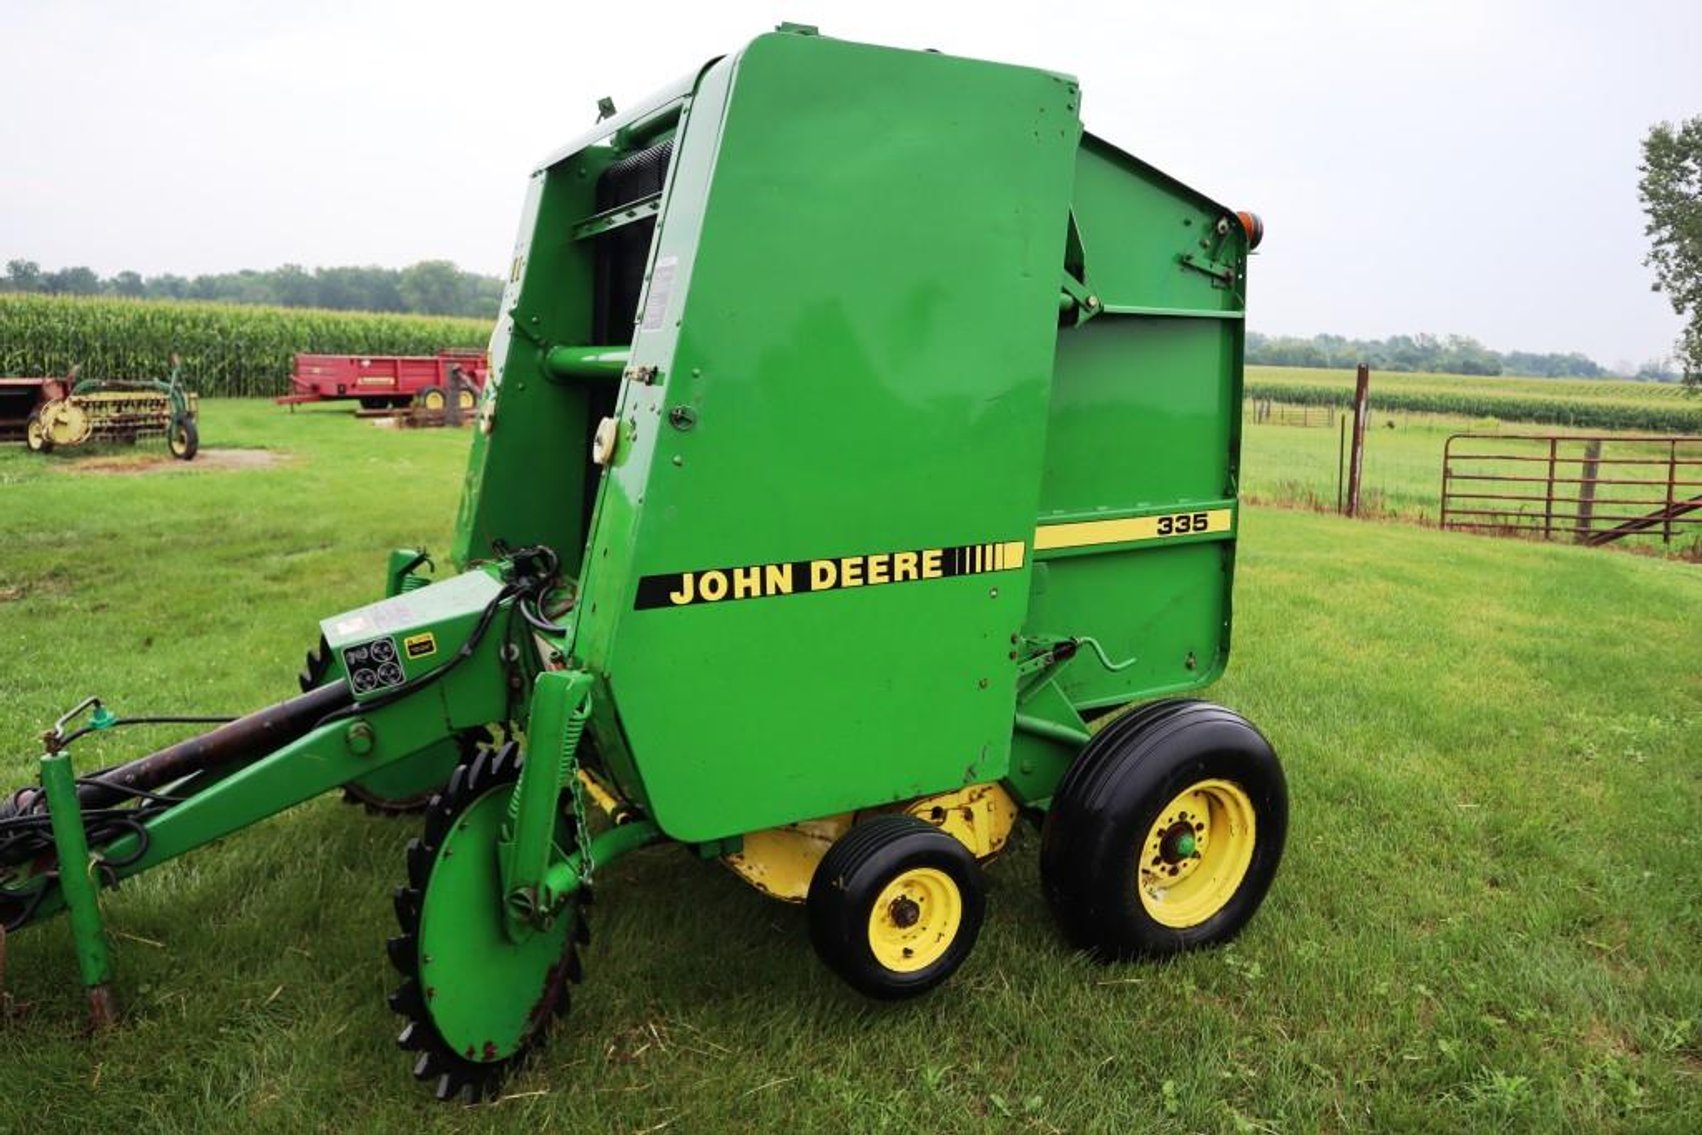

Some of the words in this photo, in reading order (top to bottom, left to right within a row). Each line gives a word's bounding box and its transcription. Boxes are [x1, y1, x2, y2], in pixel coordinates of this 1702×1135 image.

[1157, 514, 1208, 535] 335
[670, 563, 794, 606] JOHN
[810, 549, 944, 591] DEERE
